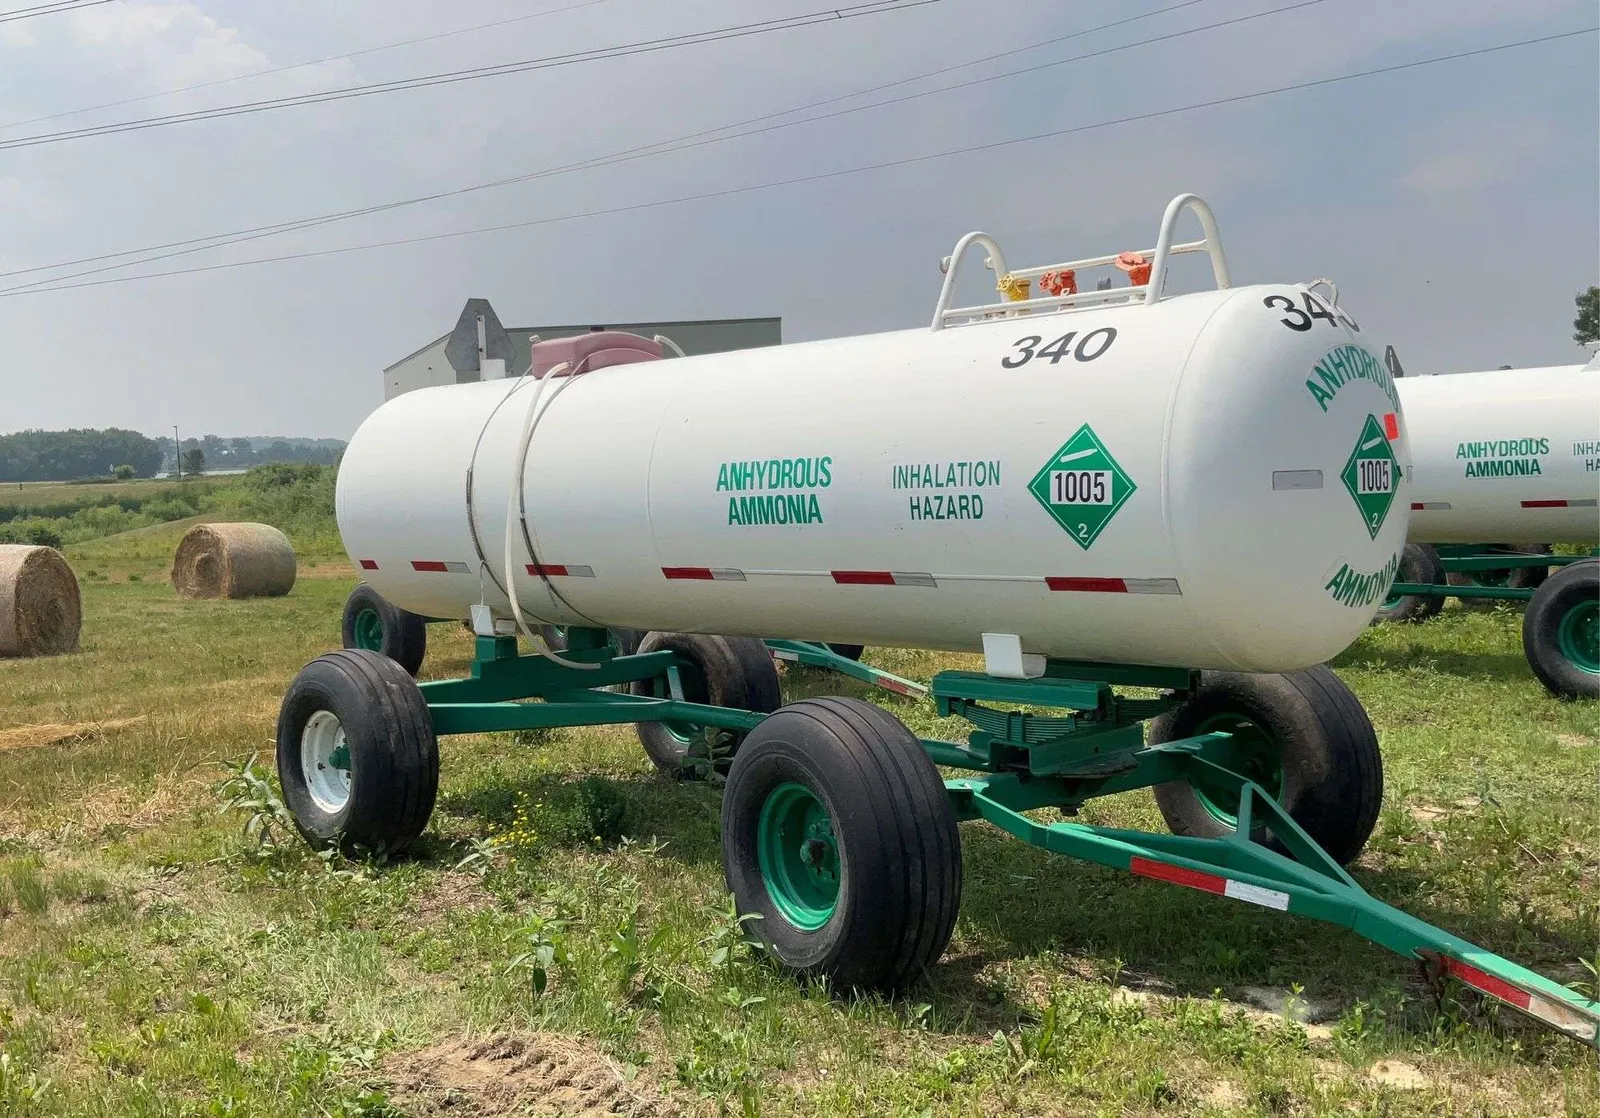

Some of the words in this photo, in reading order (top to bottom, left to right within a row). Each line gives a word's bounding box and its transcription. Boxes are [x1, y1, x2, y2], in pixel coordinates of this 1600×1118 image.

[1001, 327, 1117, 369] 340
[1456, 438, 1550, 460] ANHYDROUS
[716, 457, 832, 492] ANHYDROUS
[892, 460, 1001, 490] INHALATION
[1360, 460, 1390, 492] 1005
[1465, 459, 1542, 478] AMMONIA
[1054, 471, 1106, 504] 1005
[728, 494, 823, 526] AMMONIA
[909, 494, 984, 521] HAZARD
[1372, 512, 1379, 528] 2
[1078, 523, 1088, 538] 2
[1324, 552, 1397, 608] AMMONIA
